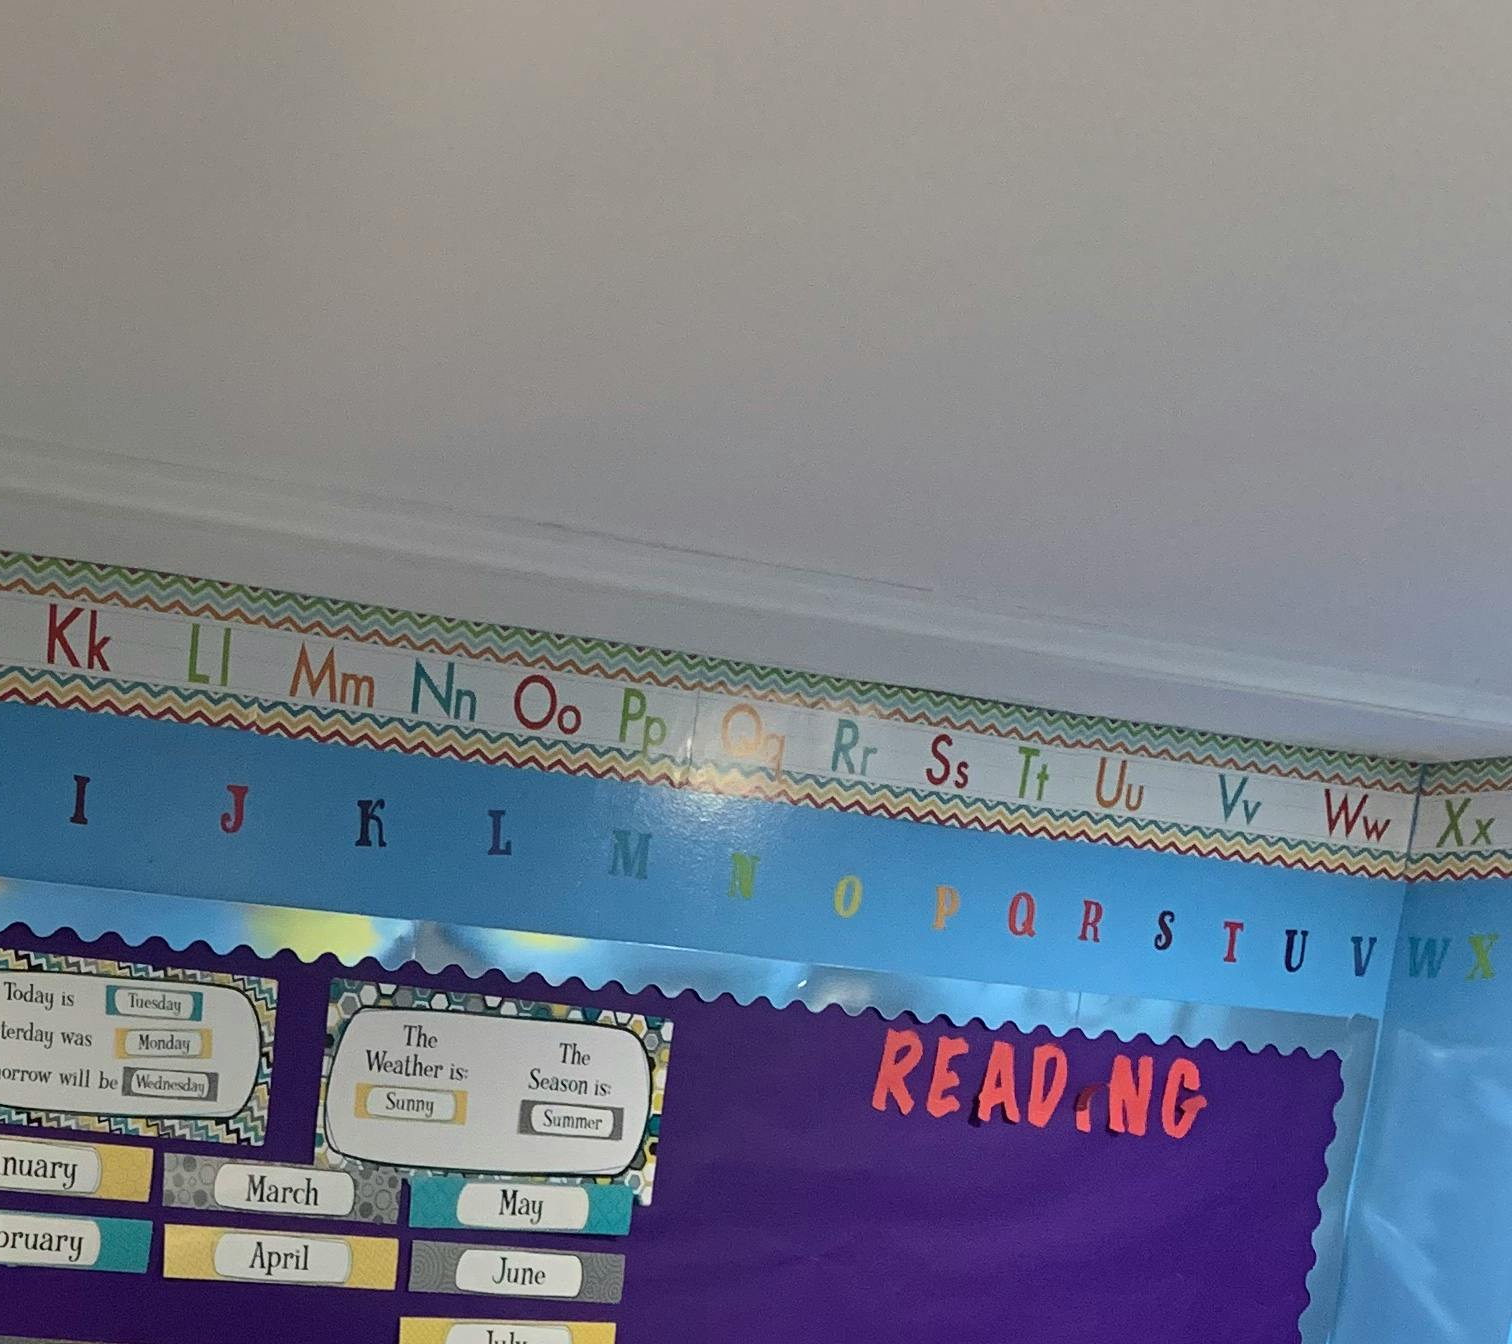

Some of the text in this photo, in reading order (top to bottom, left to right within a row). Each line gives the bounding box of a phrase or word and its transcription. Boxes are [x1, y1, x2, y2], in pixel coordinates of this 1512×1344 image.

[48, 605, 111, 671] Kk
[412, 658, 477, 722] Nn
[926, 734, 969, 789] Ss
[1324, 789, 1390, 842] Ww
[356, 799, 387, 848] K
[1078, 900, 1103, 942] R
[1283, 929, 1309, 972] U
[1464, 934, 1500, 980] X
[4, 982, 182, 1016] Today is Tuesday
[61, 1031, 92, 1047] was
[139, 1035, 190, 1056] Monday
[404, 1025, 438, 1049] The
[366, 1050, 468, 1080] Weather is:
[560, 1043, 590, 1066] The
[59, 1069, 89, 1088] will
[98, 1076, 118, 1090] be
[136, 1074, 205, 1095] Wednesday
[528, 1068, 612, 1096] Season is:
[386, 1092, 434, 1118] Sunny
[543, 1109, 602, 1131] Summer
[246, 1174, 320, 1207] March
[499, 1189, 543, 1224] May
[249, 1241, 310, 1276] April
[492, 1257, 546, 1285] June
